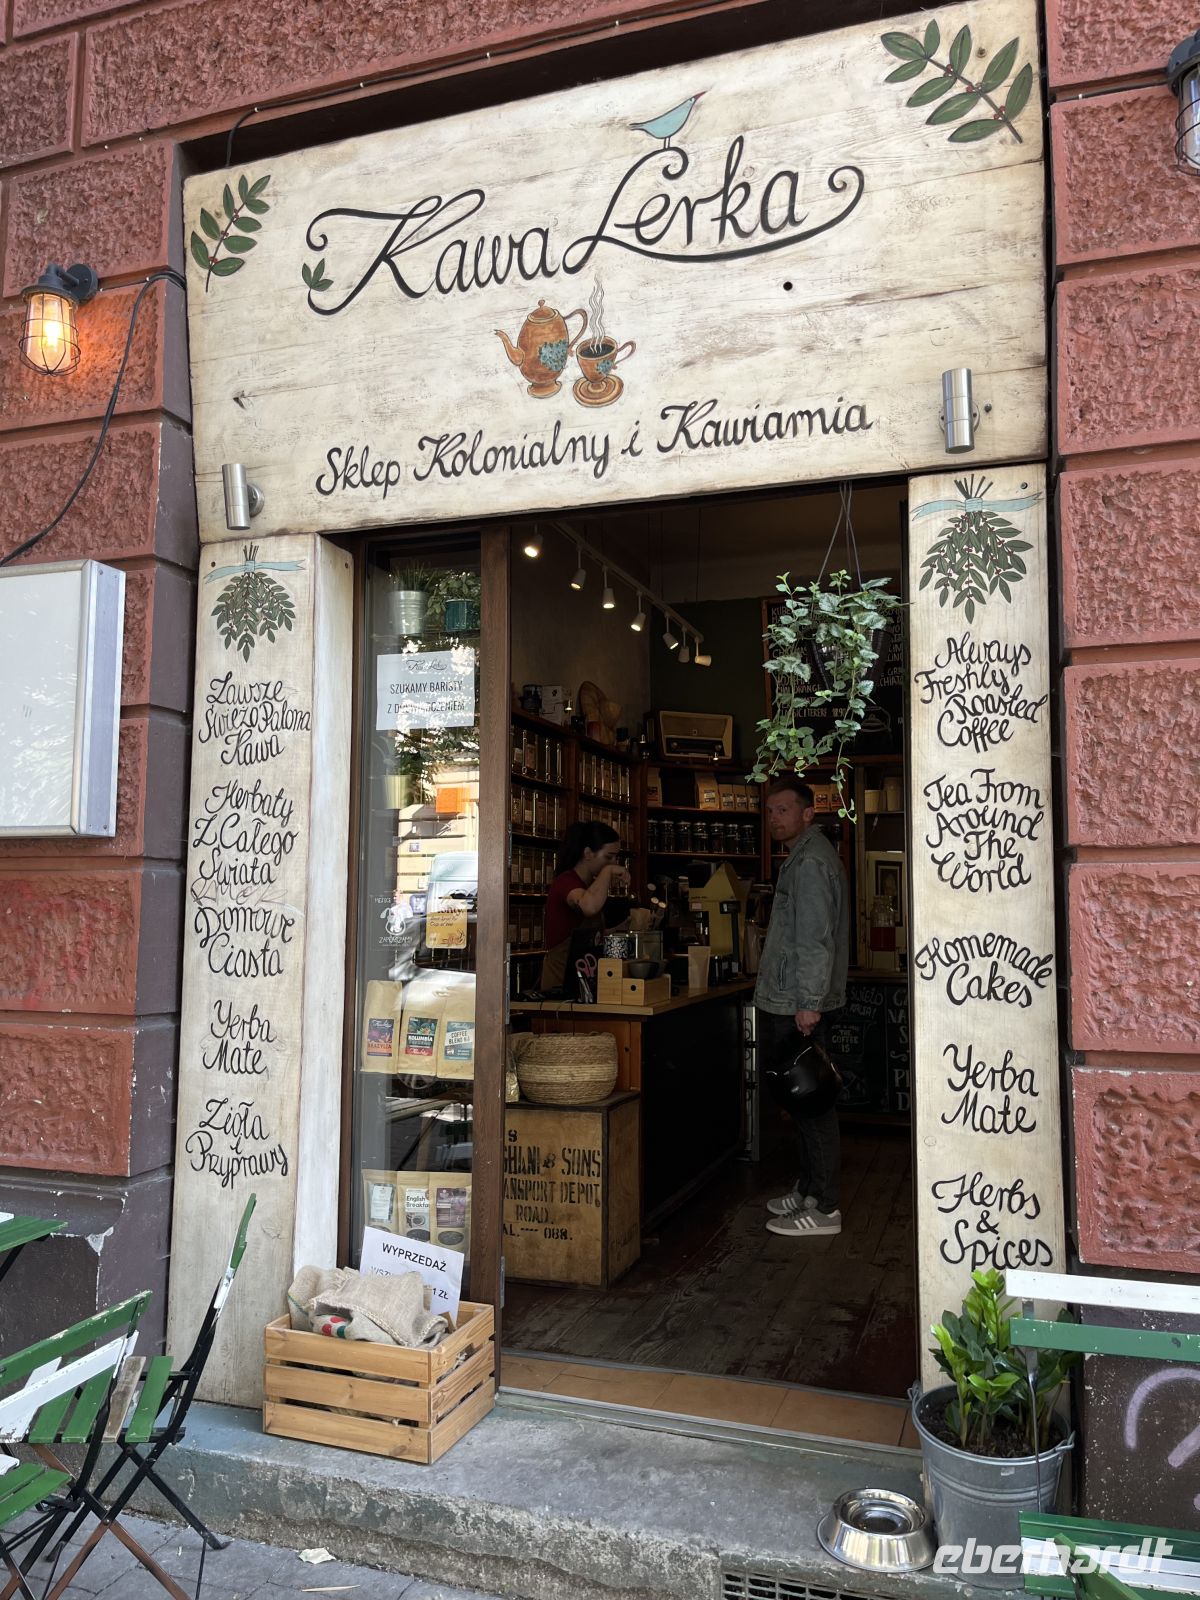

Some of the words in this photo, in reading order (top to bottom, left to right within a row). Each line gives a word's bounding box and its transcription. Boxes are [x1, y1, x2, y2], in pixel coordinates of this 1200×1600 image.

[316, 447, 400, 498] Sklep
[413, 420, 611, 479] Kolonialny
[620, 432, 643, 458] i
[656, 398, 873, 453] Kawiarnia
[935, 631, 1031, 676] Always
[207, 671, 285, 705] Zawsze
[390, 682, 428, 694] SZUKAMY
[915, 662, 1010, 704] Freshly
[945, 684, 1048, 724] Roasted
[199, 703, 259, 743] Świeżo
[258, 701, 311, 733] Palona
[387, 704, 392, 714] Z
[220, 729, 285, 766] Kawa
[937, 709, 1014, 753] Coffee
[205, 779, 294, 828] Herbaty
[923, 774, 973, 812] Tea
[971, 768, 1045, 809] From
[193, 814, 218, 848] Z
[219, 813, 299, 866] Całego
[926, 804, 1044, 848] Around
[963, 829, 1018, 861] The
[199, 844, 278, 886] Świata
[931, 852, 1032, 893] World
[194, 906, 295, 948] Domowe
[208, 933, 284, 978] Ciasta
[915, 932, 1054, 988] Homemade
[946, 961, 1032, 1008] Cakes
[210, 1000, 278, 1043] Yerba
[203, 1038, 269, 1074] Mate
[943, 1043, 1038, 1097] Yerba
[199, 1097, 270, 1140] Zioła
[941, 1089, 1036, 1135] Mate
[185, 1130, 288, 1189] Przyprawy
[230, 1134, 242, 1154] i
[561, 1147, 600, 1178] SONS
[406, 1195, 426, 1203] English
[503, 1177, 556, 1203] ANSPORT
[931, 1172, 1040, 1220] Herbs
[975, 1210, 999, 1234] &
[382, 1242, 447, 1272] WYPRZEDAŻ
[940, 1219, 1053, 1271] Spices
[438, 1289, 449, 1300] ZŁ
